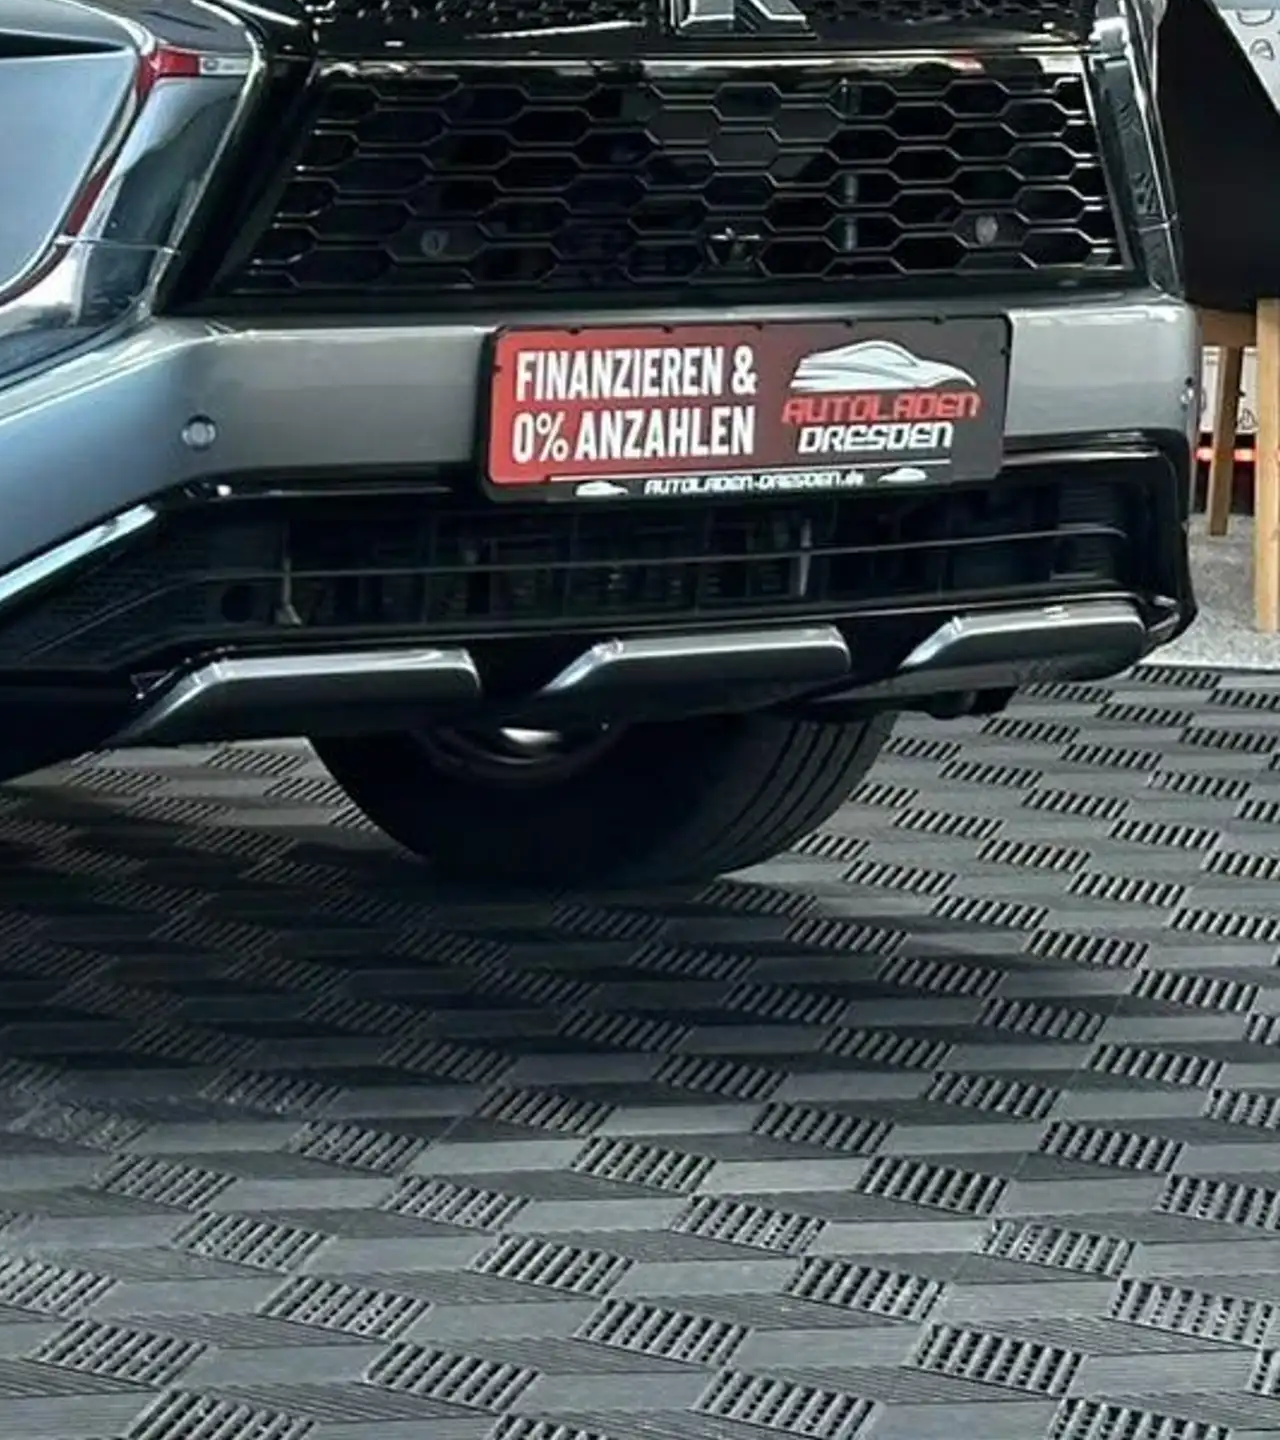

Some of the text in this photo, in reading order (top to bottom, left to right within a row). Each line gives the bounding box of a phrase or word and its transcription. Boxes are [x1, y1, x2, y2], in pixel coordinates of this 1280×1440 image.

[515, 345, 759, 402] FINANZIEREN &
[512, 405, 756, 464] 0% ANZAHLEN
[797, 421, 953, 454] DRESDEN
